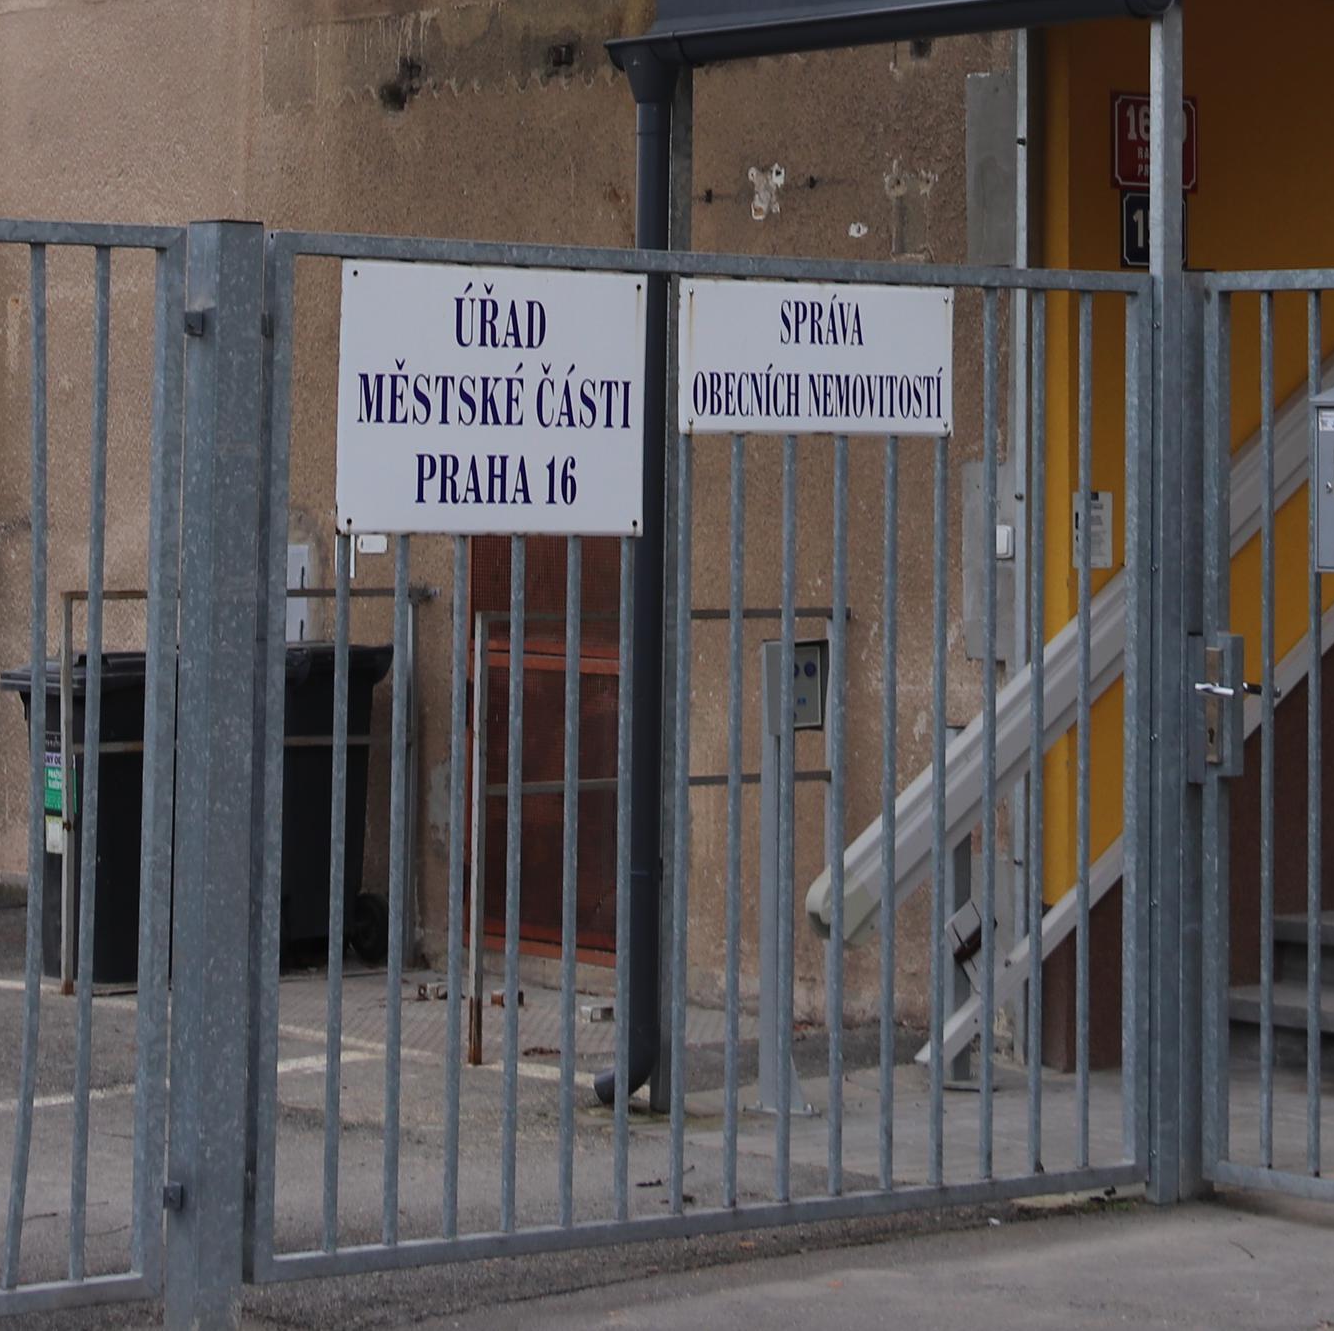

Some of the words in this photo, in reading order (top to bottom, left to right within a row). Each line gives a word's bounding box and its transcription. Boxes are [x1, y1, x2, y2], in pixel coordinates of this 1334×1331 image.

[454, 281, 547, 350] ÚŘAD
[780, 293, 864, 347] SPRÁVA
[356, 358, 524, 428] MĚSTSKÉ
[536, 362, 633, 430] ČÁSTI
[692, 363, 800, 419] OBECNÍCH
[807, 366, 944, 420] NEMOVITOSTÍ
[414, 453, 533, 506] PRAHA
[545, 455, 578, 507] 16
